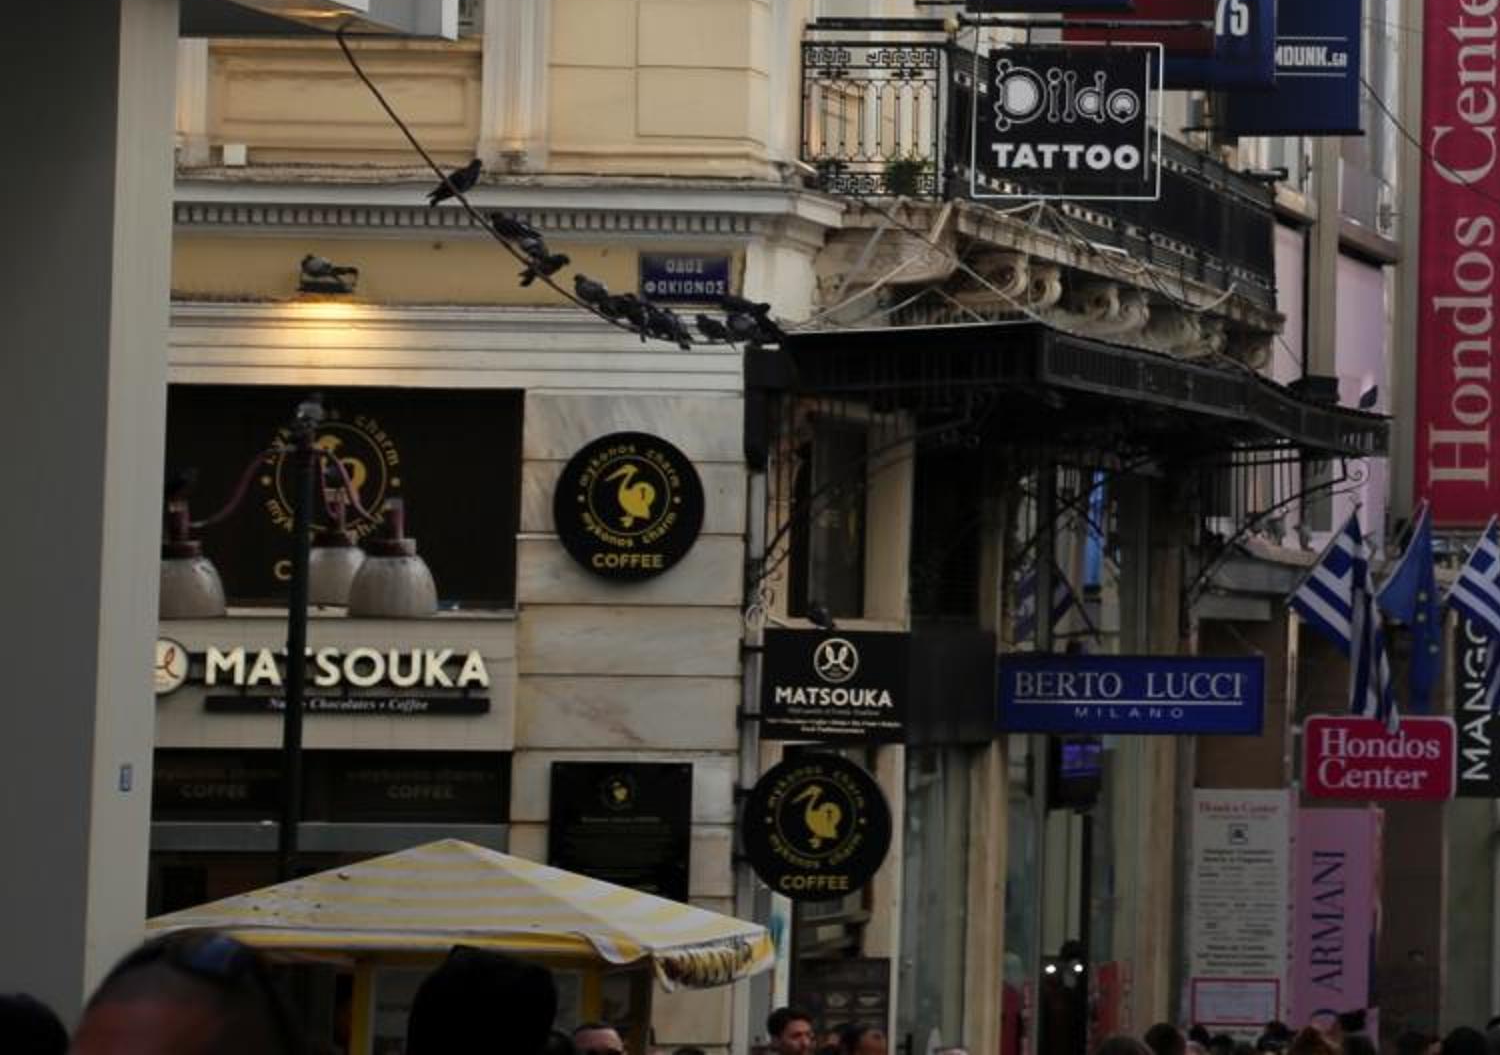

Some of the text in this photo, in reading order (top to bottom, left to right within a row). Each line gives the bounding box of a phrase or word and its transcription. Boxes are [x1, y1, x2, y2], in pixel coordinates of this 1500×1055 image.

[991, 143, 1140, 170] TATTOO
[1426, 214, 1496, 490] Hondos
[591, 553, 665, 569] COFFEE
[205, 647, 489, 690] MASOUKA
[774, 685, 895, 709] MATSOUKA
[1014, 672, 1243, 699] BERTO LUCCI
[1074, 706, 1184, 719] MILANO
[1319, 727, 1441, 759] Hondos
[1318, 758, 1428, 790] Center
[780, 874, 849, 890] COFFEE
[1311, 850, 1345, 993] ARMANI
